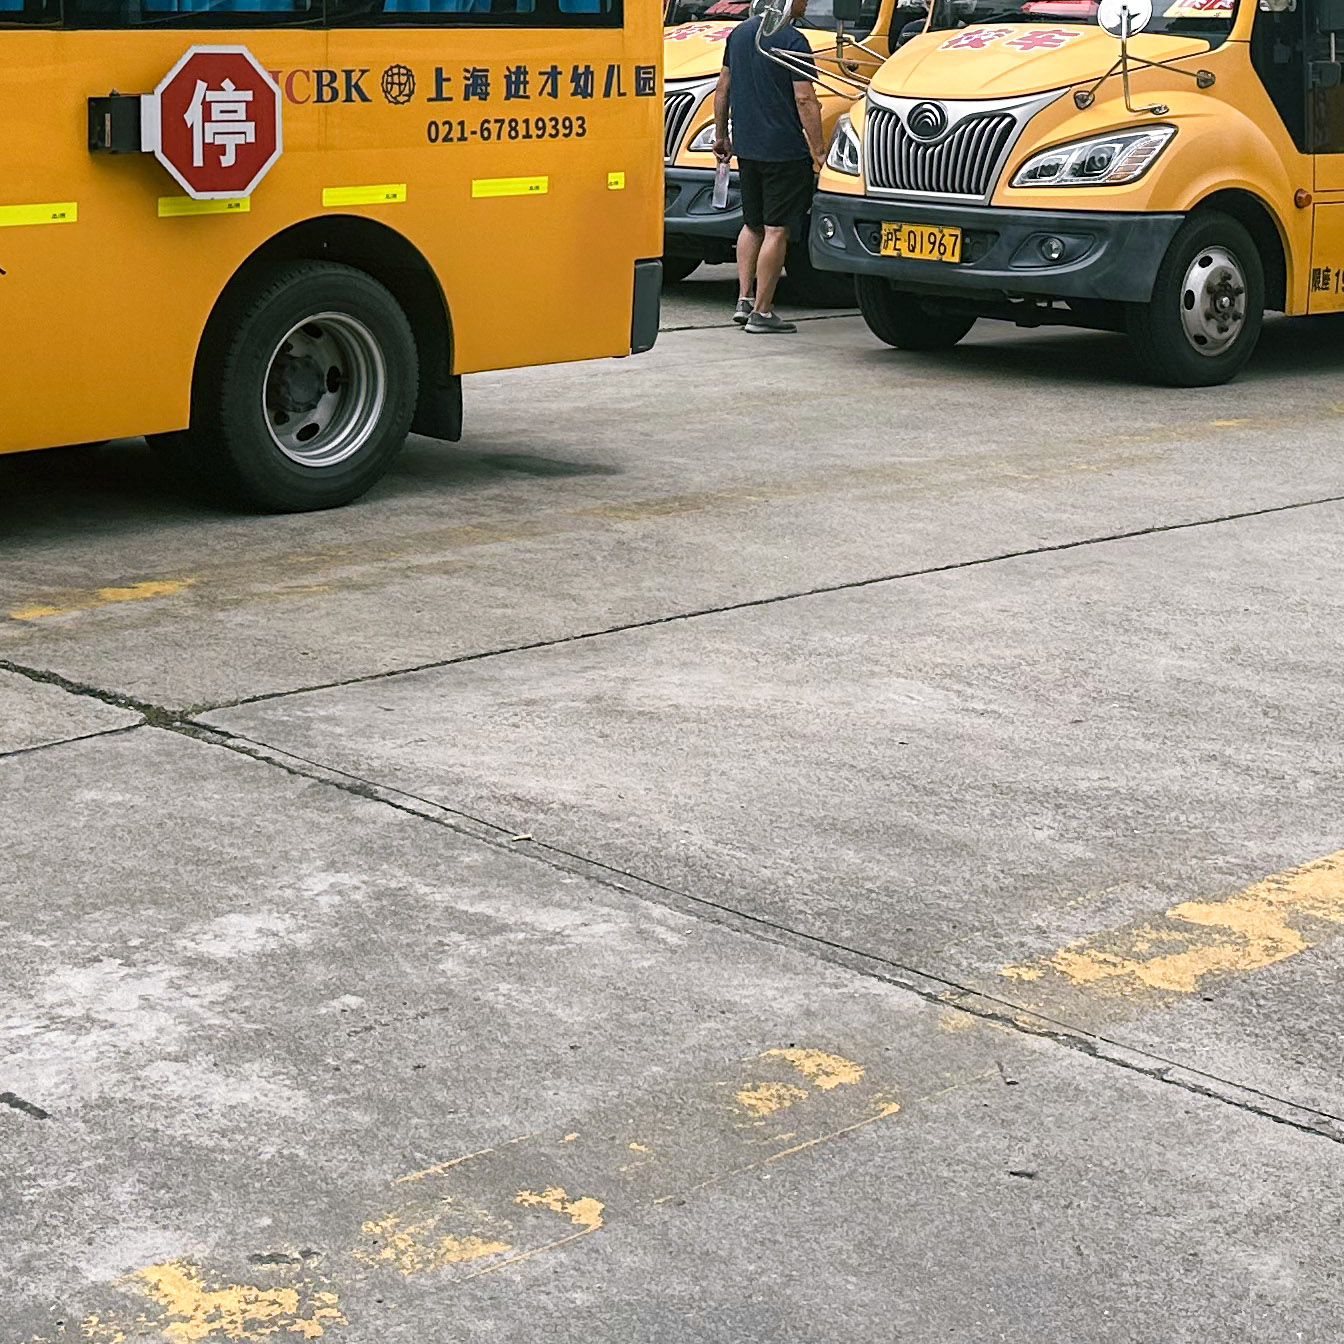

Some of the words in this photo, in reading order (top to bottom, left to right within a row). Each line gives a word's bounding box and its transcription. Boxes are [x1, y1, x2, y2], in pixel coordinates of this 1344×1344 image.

[940, 27, 1082, 51] 校车
[426, 64, 658, 104] 上海进才幼儿园
[183, 78, 257, 168] 停
[426, 116, 587, 144] 021-67819393
